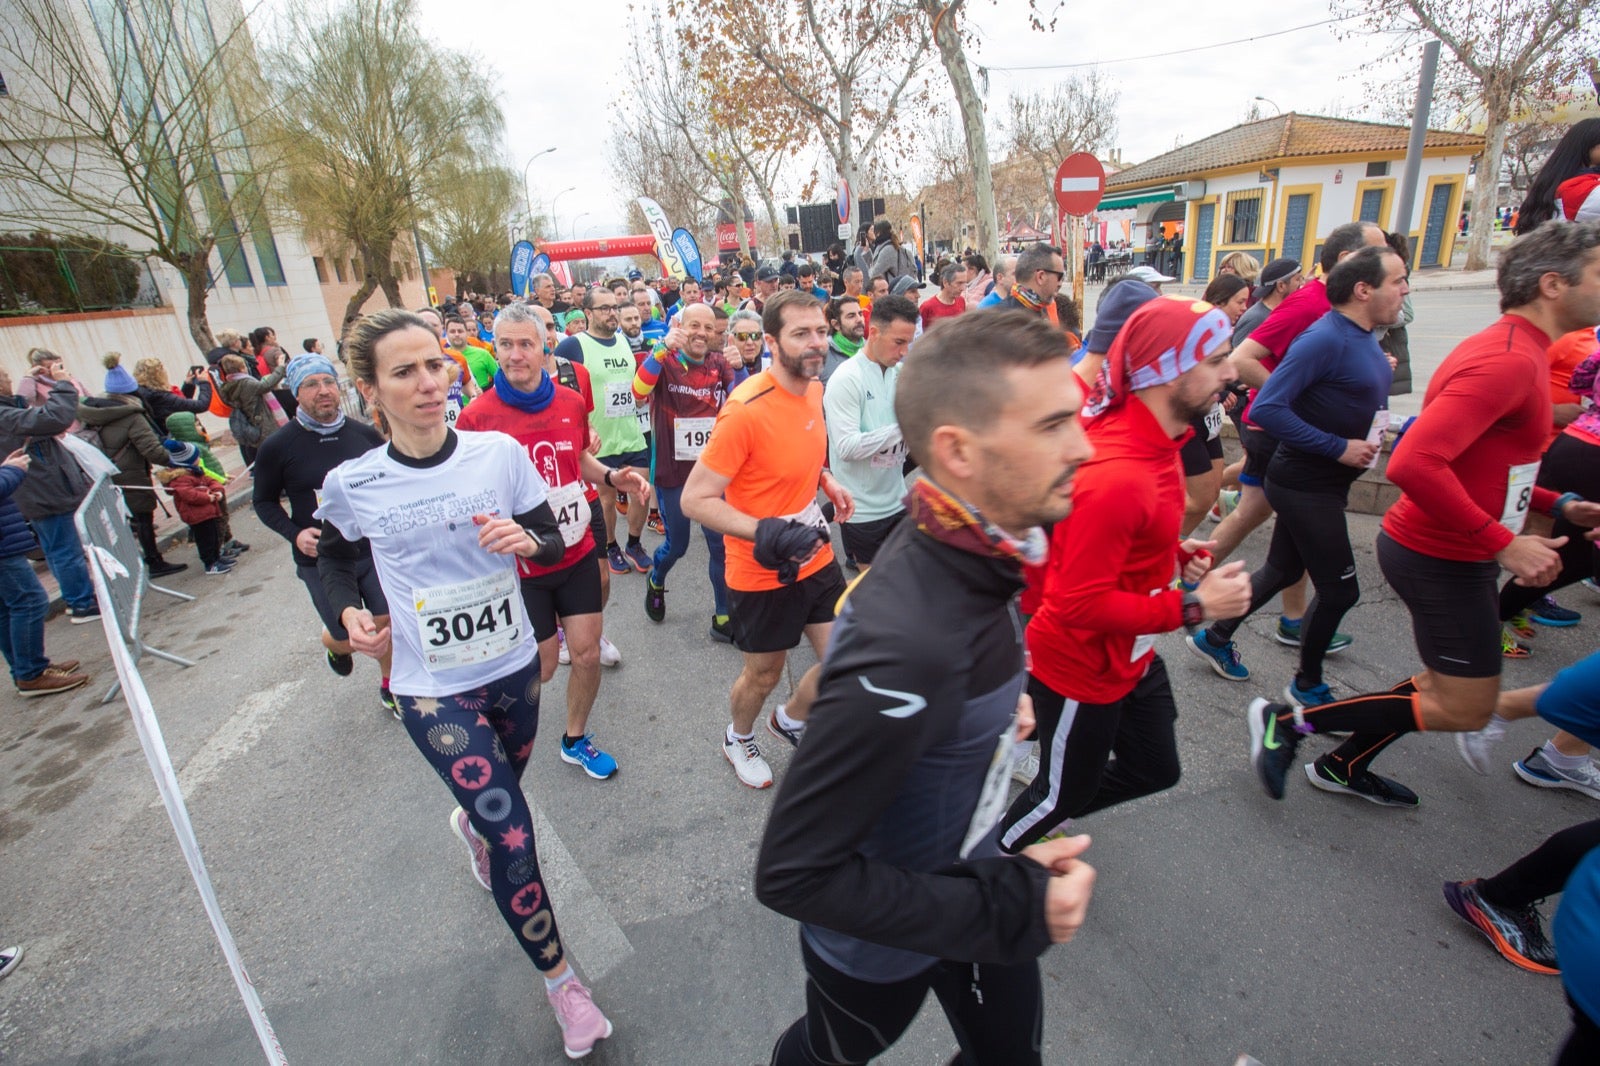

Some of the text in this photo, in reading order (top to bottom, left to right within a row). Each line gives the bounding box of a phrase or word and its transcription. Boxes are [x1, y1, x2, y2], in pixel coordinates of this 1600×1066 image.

[604, 357, 628, 368] FILA
[612, 391, 632, 406] 258
[398, 492, 456, 511] TotalEnergies
[448, 488, 497, 510] maratón
[383, 516, 428, 536] CIUDAD
[431, 512, 446, 524] DE
[448, 499, 498, 519] GRANADA
[426, 597, 513, 647] 3041
